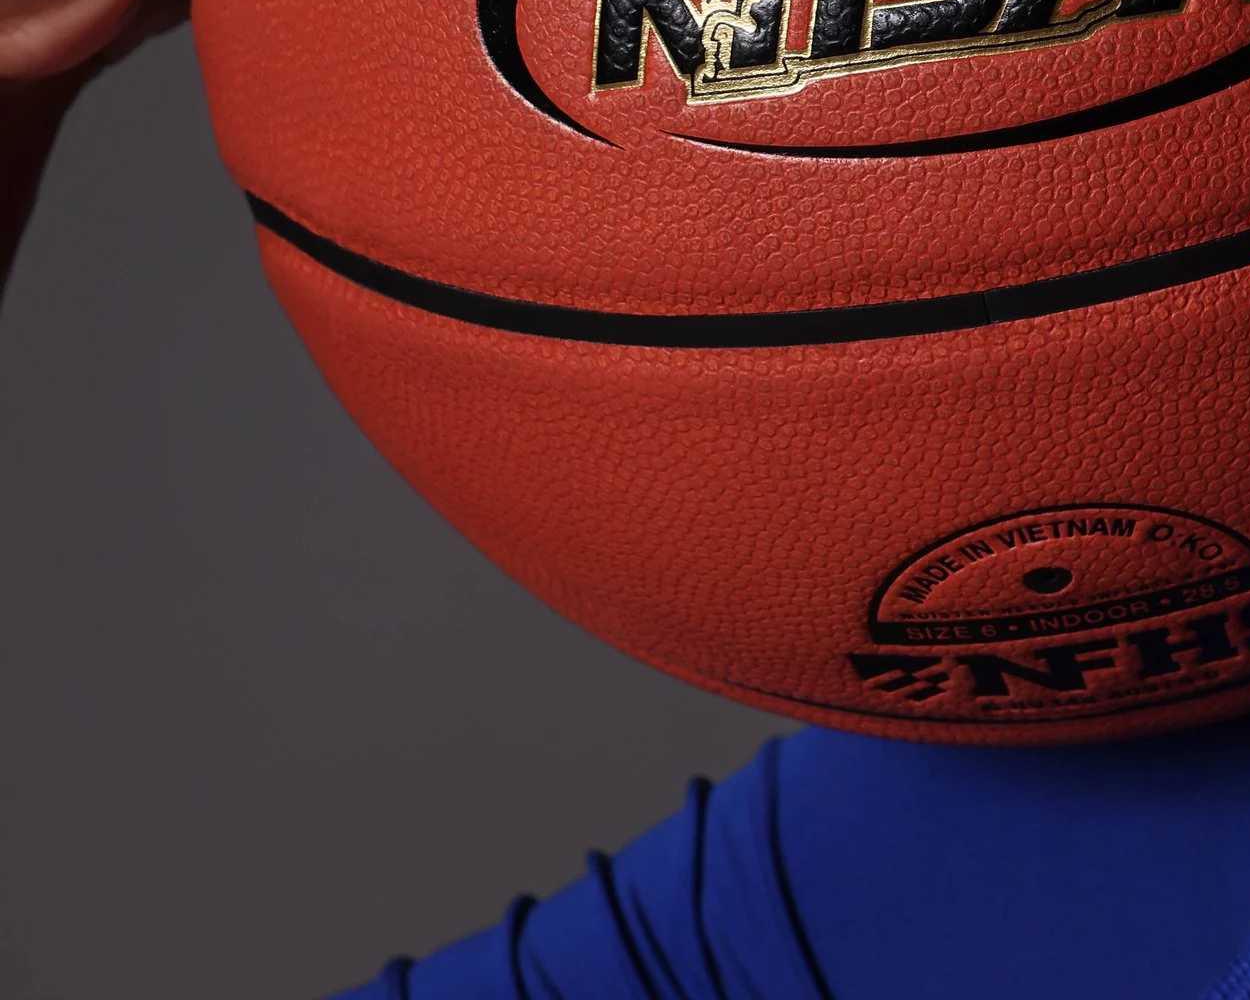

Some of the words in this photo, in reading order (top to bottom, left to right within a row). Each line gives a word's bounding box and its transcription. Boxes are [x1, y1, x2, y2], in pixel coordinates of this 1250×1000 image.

[900, 554, 965, 604] MADE
[959, 539, 996, 563] IN
[995, 518, 1138, 549] VIETNAM
[906, 625, 972, 641] SIZE
[980, 624, 998, 638] 6
[1029, 600, 1149, 632] INDOOR
